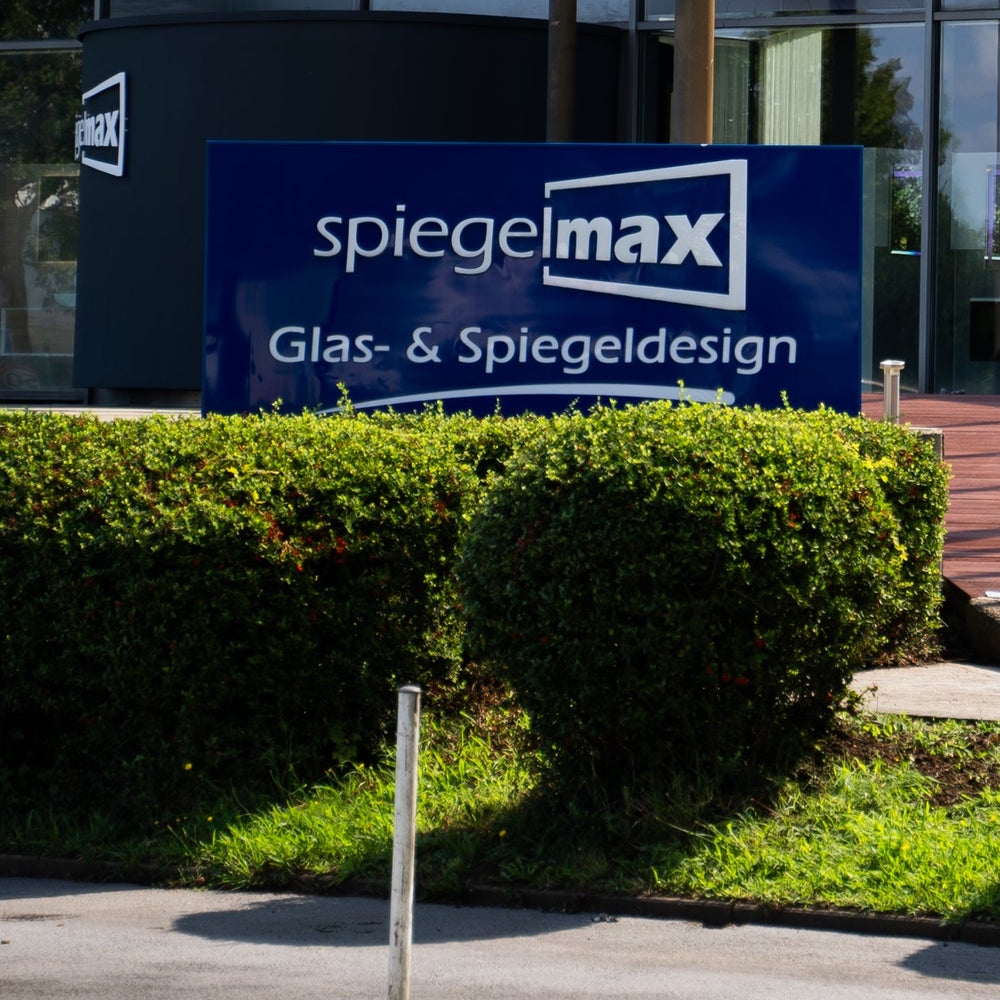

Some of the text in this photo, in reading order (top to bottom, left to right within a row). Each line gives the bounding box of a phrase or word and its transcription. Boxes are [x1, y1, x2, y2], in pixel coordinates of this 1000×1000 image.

[313, 204, 723, 275] spiegelmax
[267, 325, 799, 376] Glas- & Spiegeldesign
